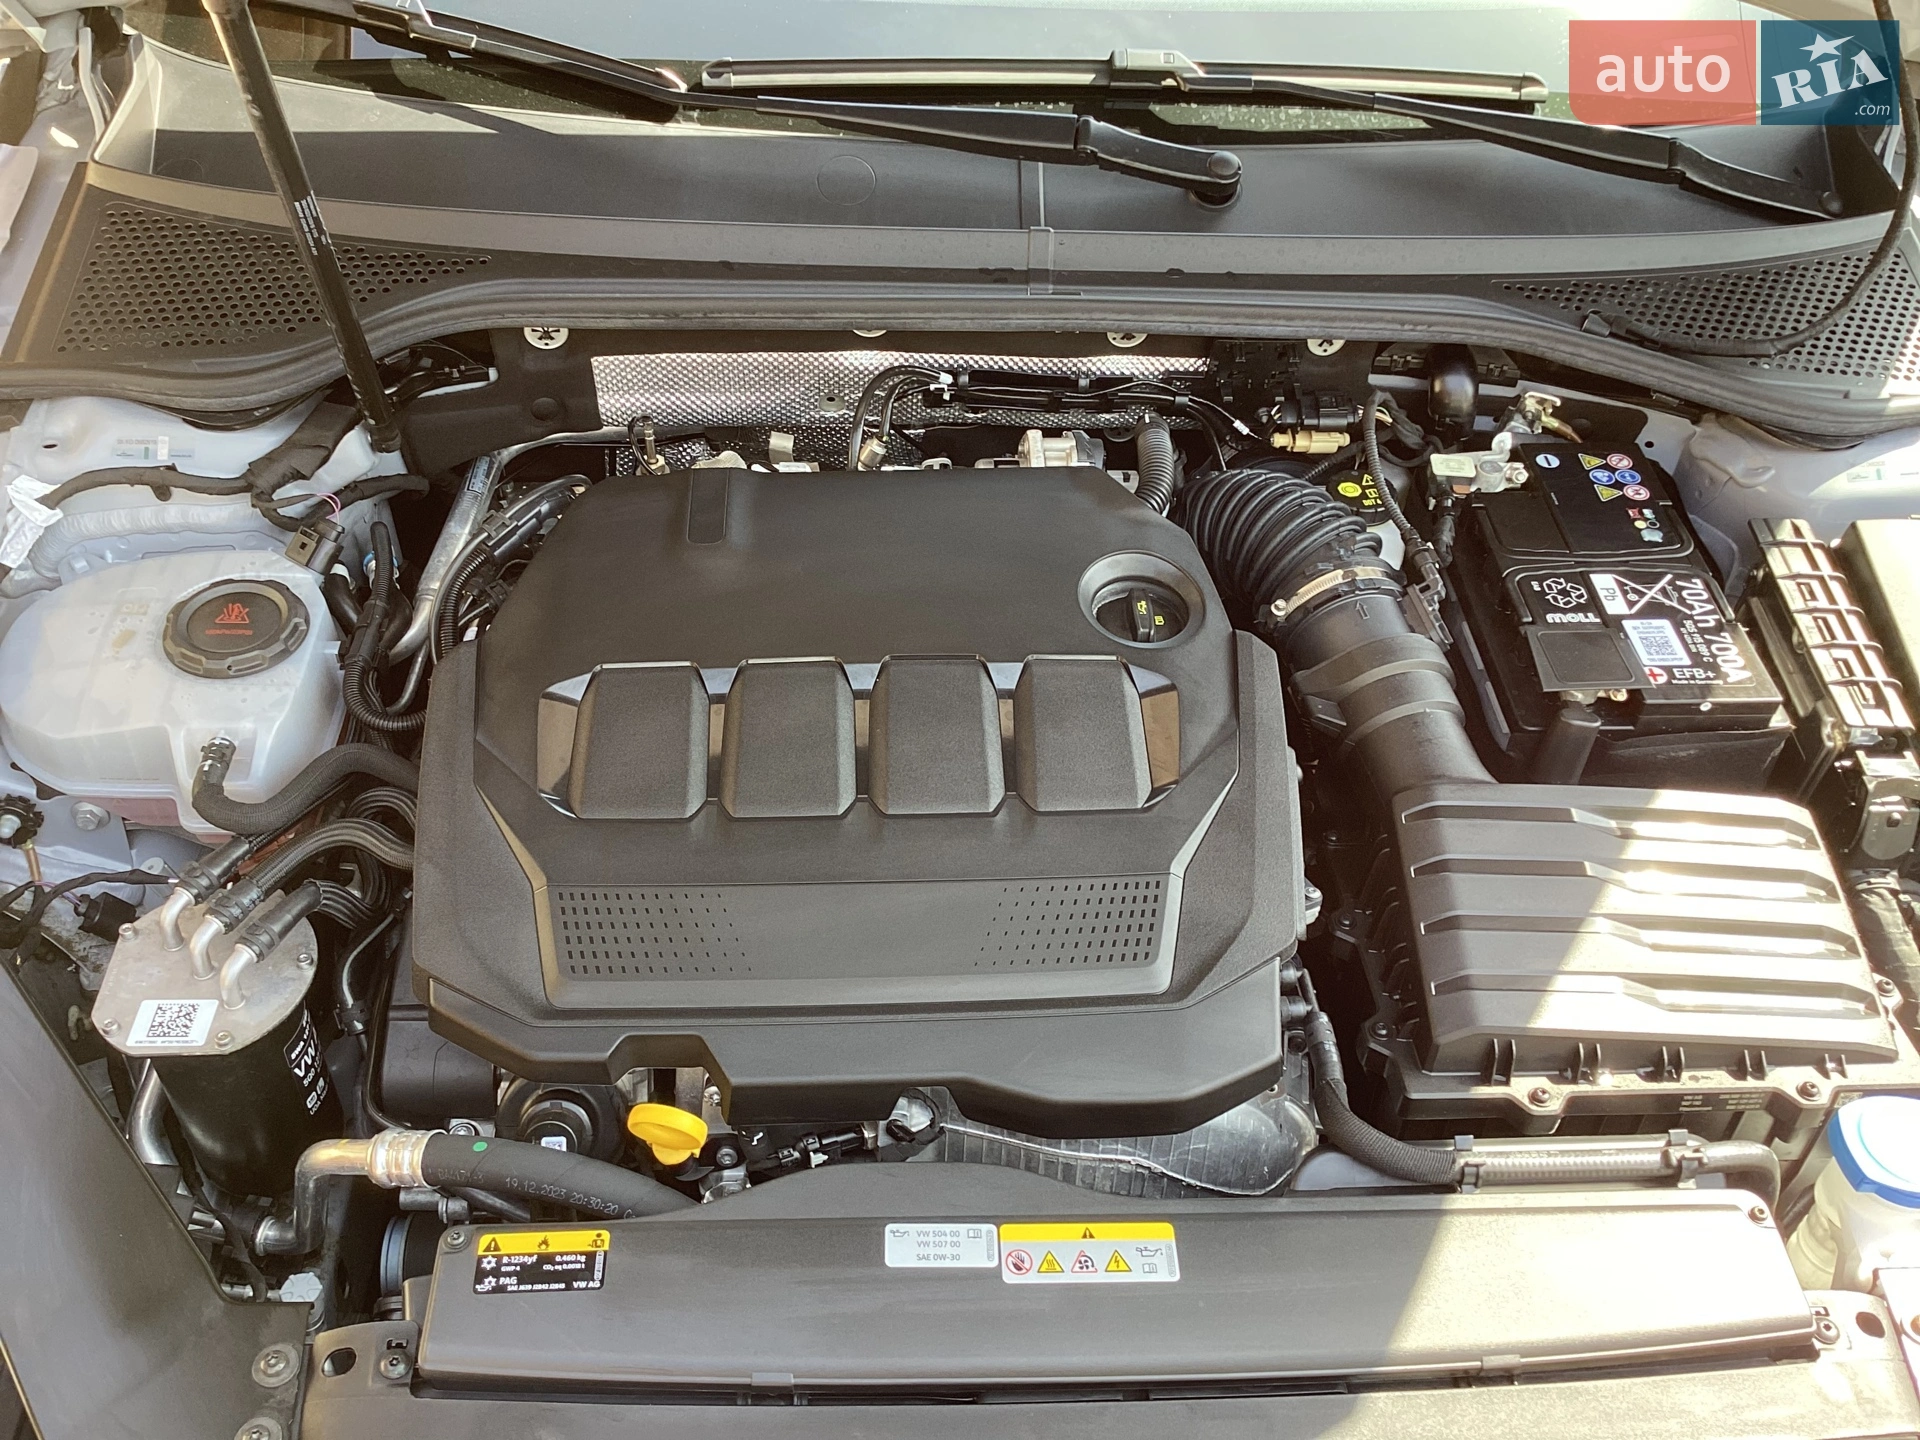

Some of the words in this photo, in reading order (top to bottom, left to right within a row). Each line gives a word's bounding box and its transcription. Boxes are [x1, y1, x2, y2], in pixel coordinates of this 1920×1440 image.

[1600, 587, 1619, 601] Pb
[1675, 578, 1720, 628] 70Ah
[1703, 632, 1752, 683] 700A
[1672, 667, 1717, 679] EFB+
[293, 1039, 315, 1077] VW
[505, 1176, 567, 1199] 19.12.2023
[569, 1191, 618, 1216] 20:30:20
[916, 1230, 931, 1238] VW
[932, 1230, 948, 1238] 504
[949, 1230, 961, 1238] 00
[916, 1240, 931, 1248] VW
[932, 1240, 948, 1248] 507
[949, 1240, 961, 1248] 00
[502, 1254, 538, 1265] R-1234yf
[555, 1254, 577, 1262] 0.460
[577, 1254, 586, 1262] kg
[916, 1253, 932, 1261] SAE
[932, 1253, 961, 1261] 0W-30
[499, 1276, 518, 1285] PAG
[588, 1280, 601, 1288] AG
